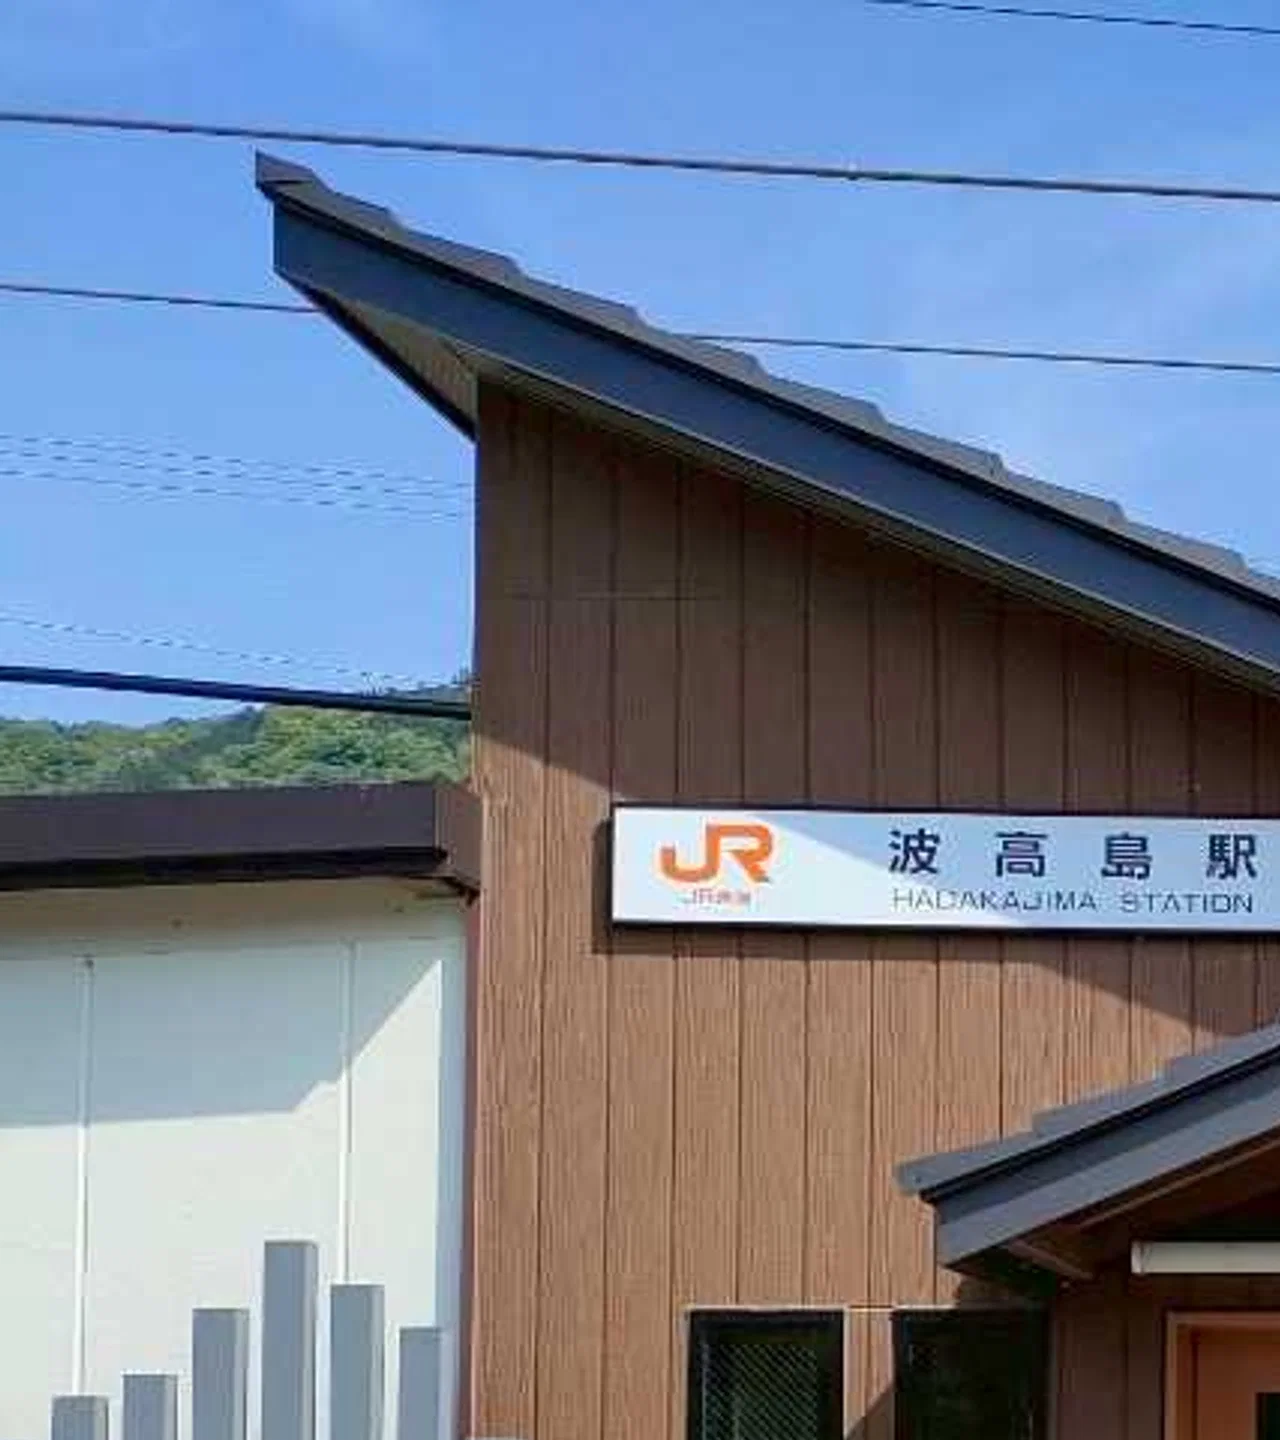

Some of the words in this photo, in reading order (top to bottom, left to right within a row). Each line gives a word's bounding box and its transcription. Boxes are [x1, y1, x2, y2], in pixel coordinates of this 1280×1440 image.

[661, 824, 772, 882] JR
[888, 828, 1257, 879] 波高島駅
[893, 888, 1097, 910] HADAKAJIMA
[1122, 893, 1253, 913] STATION
